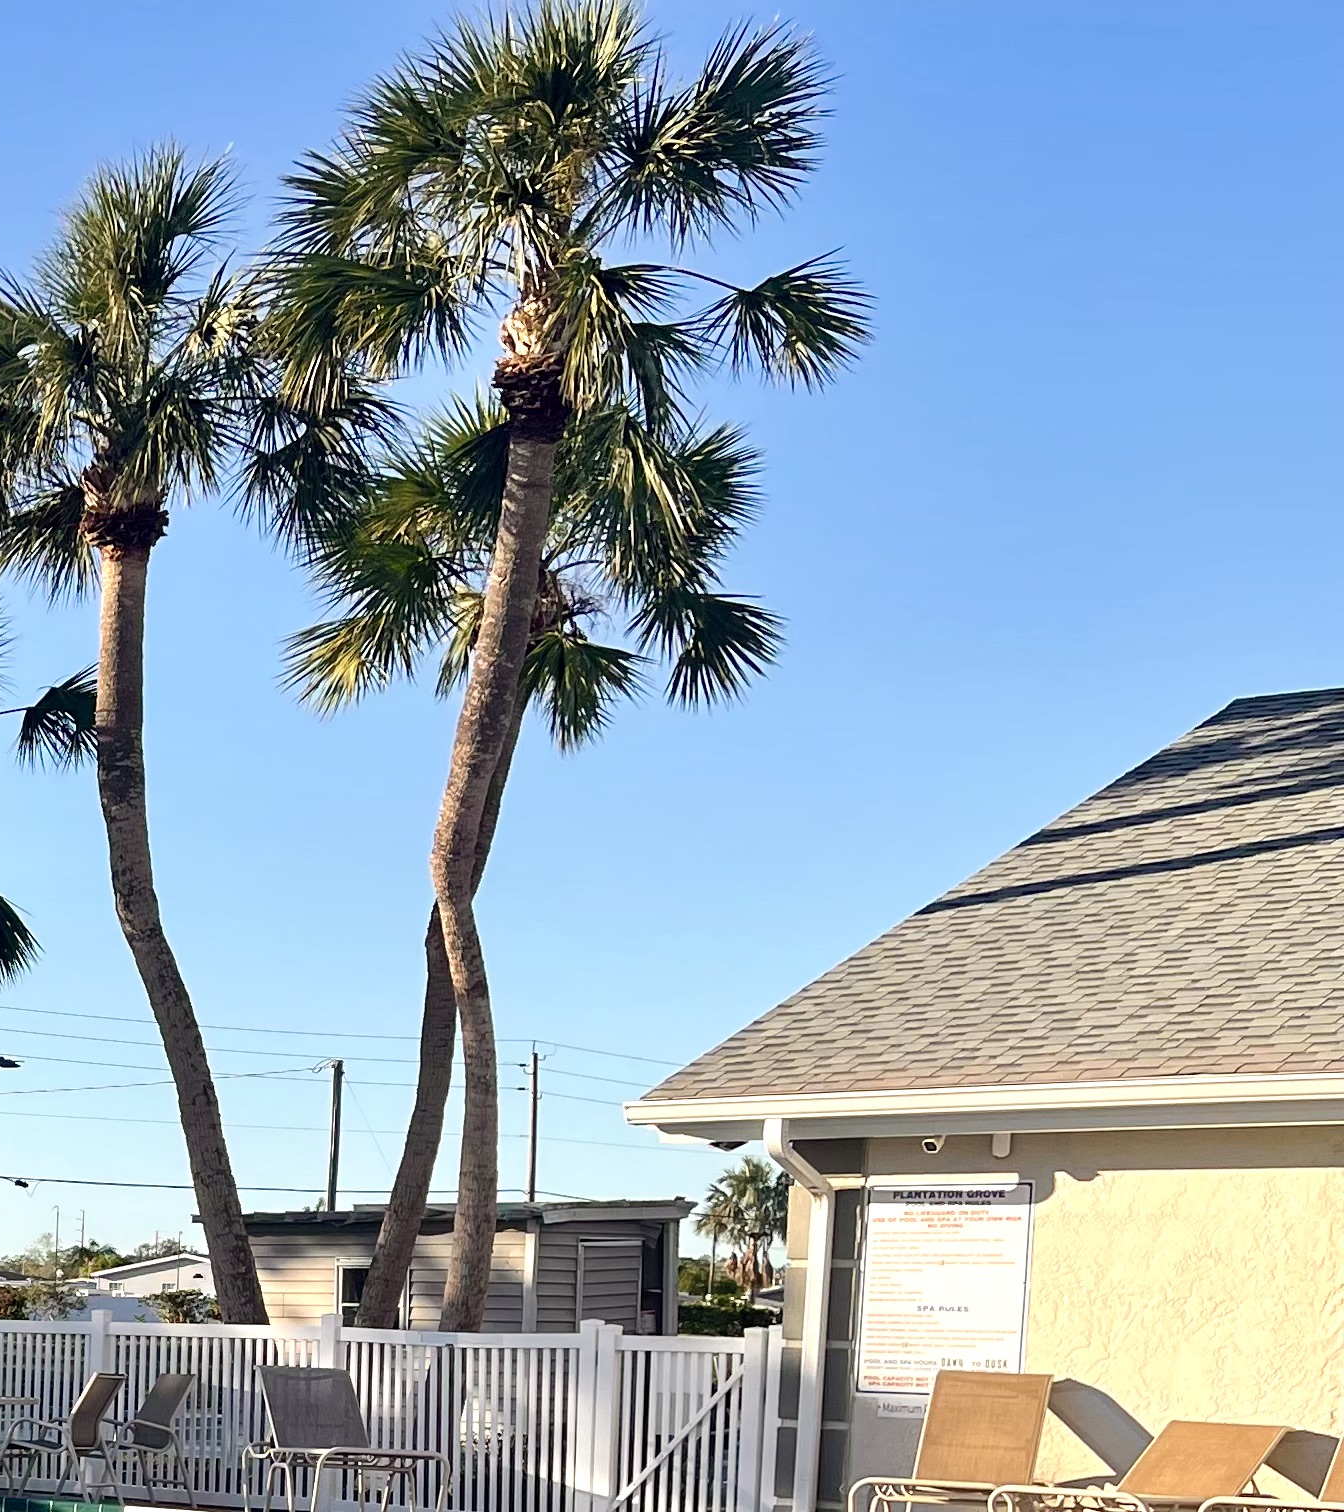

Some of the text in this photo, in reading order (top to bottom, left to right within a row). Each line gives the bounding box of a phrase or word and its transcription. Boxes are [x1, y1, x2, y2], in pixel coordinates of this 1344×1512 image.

[893, 1190, 1006, 1199] PLANTATION GROVE
[984, 1359, 1008, 1368] DUSK
[882, 1402, 922, 1414] Maximum
